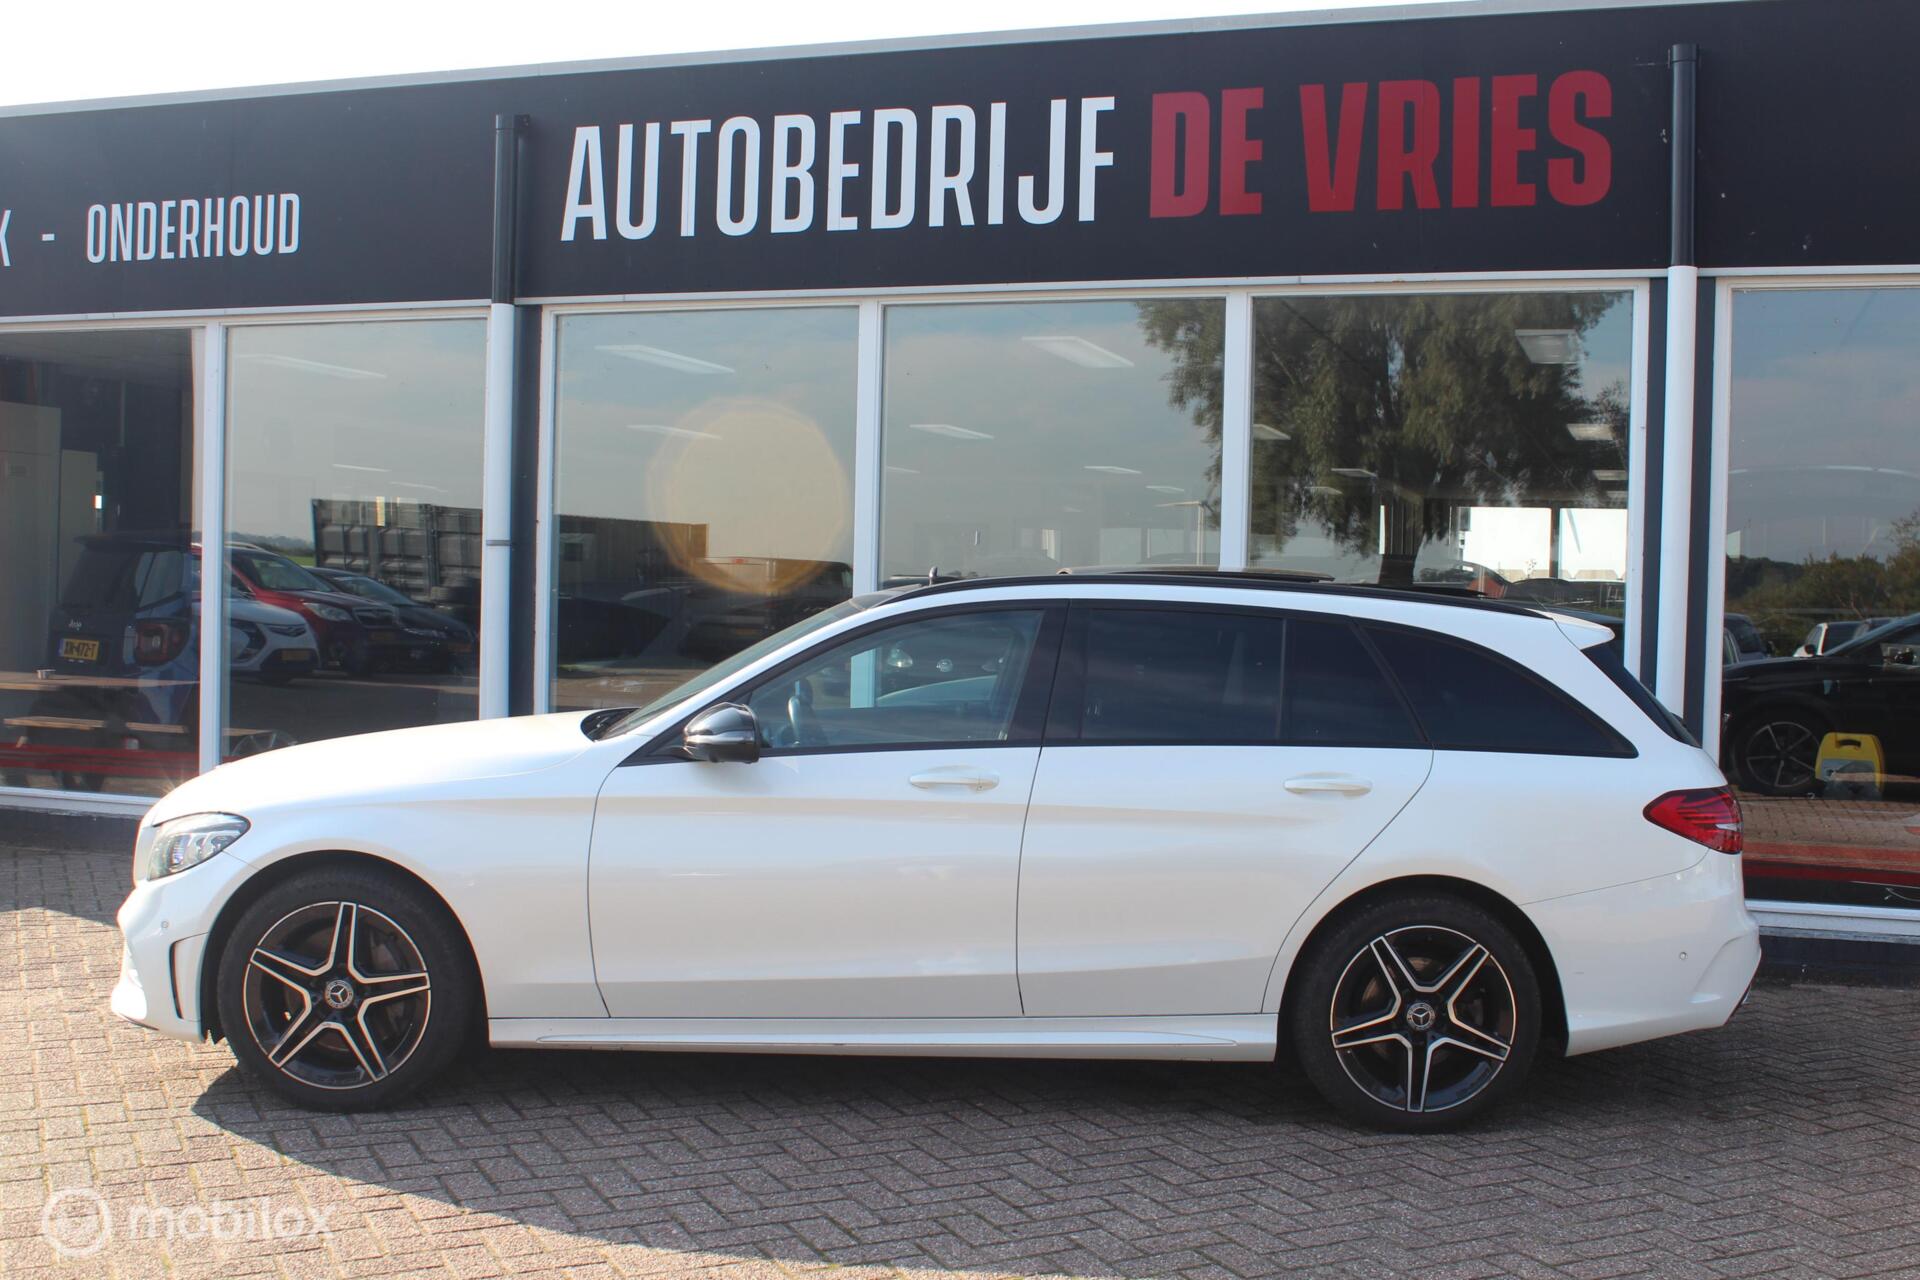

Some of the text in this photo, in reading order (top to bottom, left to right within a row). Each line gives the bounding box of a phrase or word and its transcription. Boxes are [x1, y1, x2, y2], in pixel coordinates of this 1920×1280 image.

[561, 70, 1612, 241] AUTOBEDRIJF DE VRIES
[86, 193, 300, 263] ONDERHOUD
